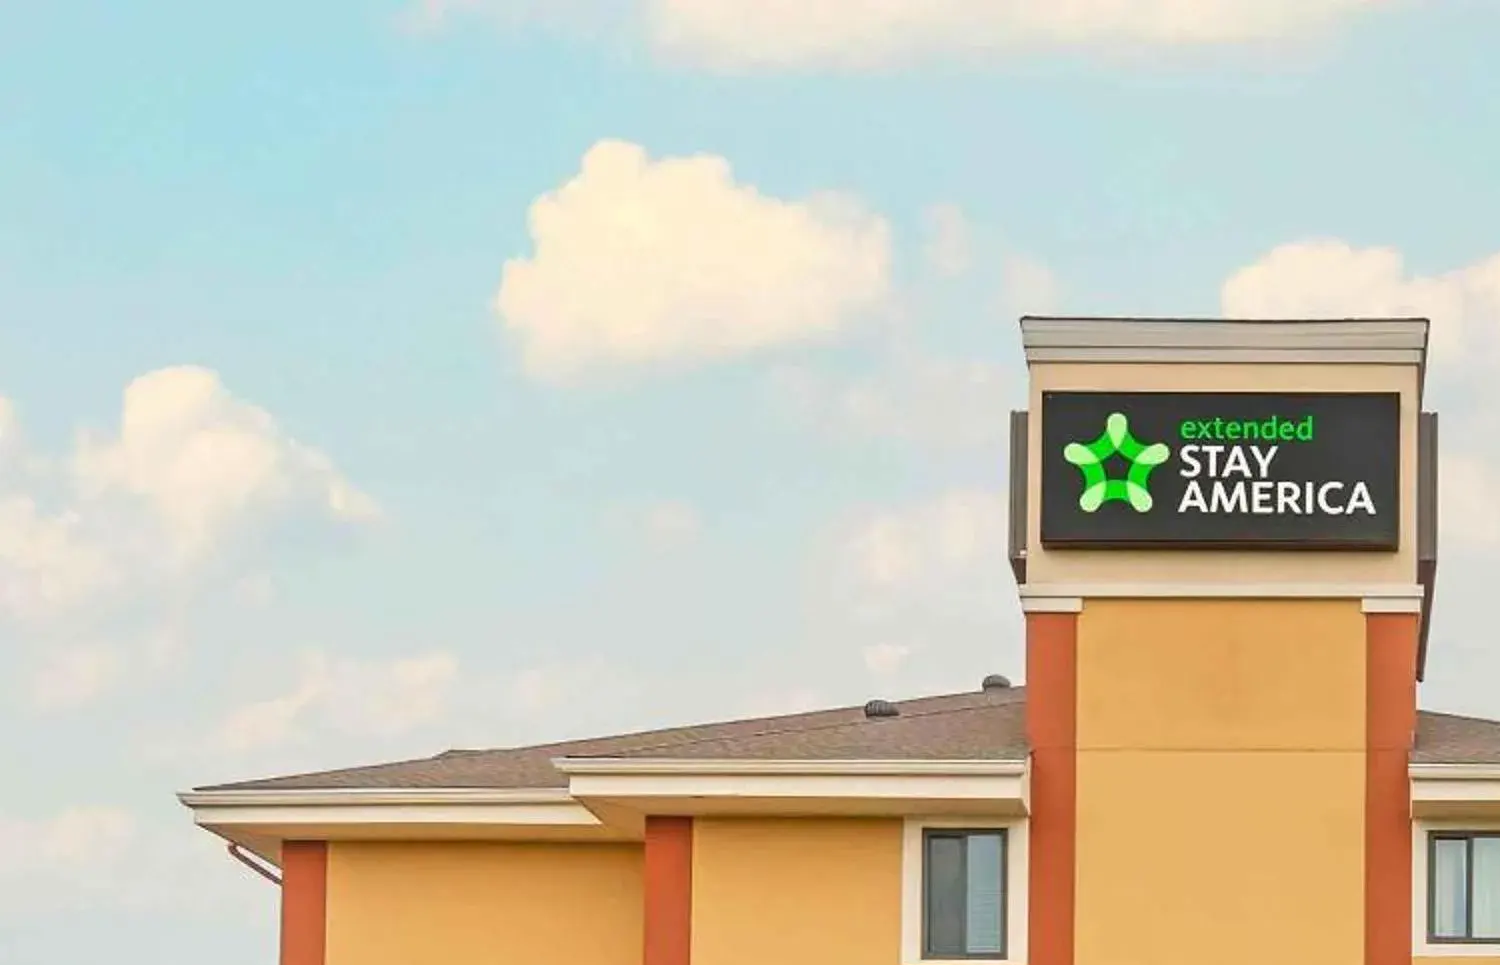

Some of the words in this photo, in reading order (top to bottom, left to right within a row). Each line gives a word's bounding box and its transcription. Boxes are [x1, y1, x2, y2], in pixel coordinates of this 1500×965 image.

[1180, 415, 1313, 442] extended
[1179, 445, 1279, 479] STAY
[1177, 480, 1377, 515] AMERICA
